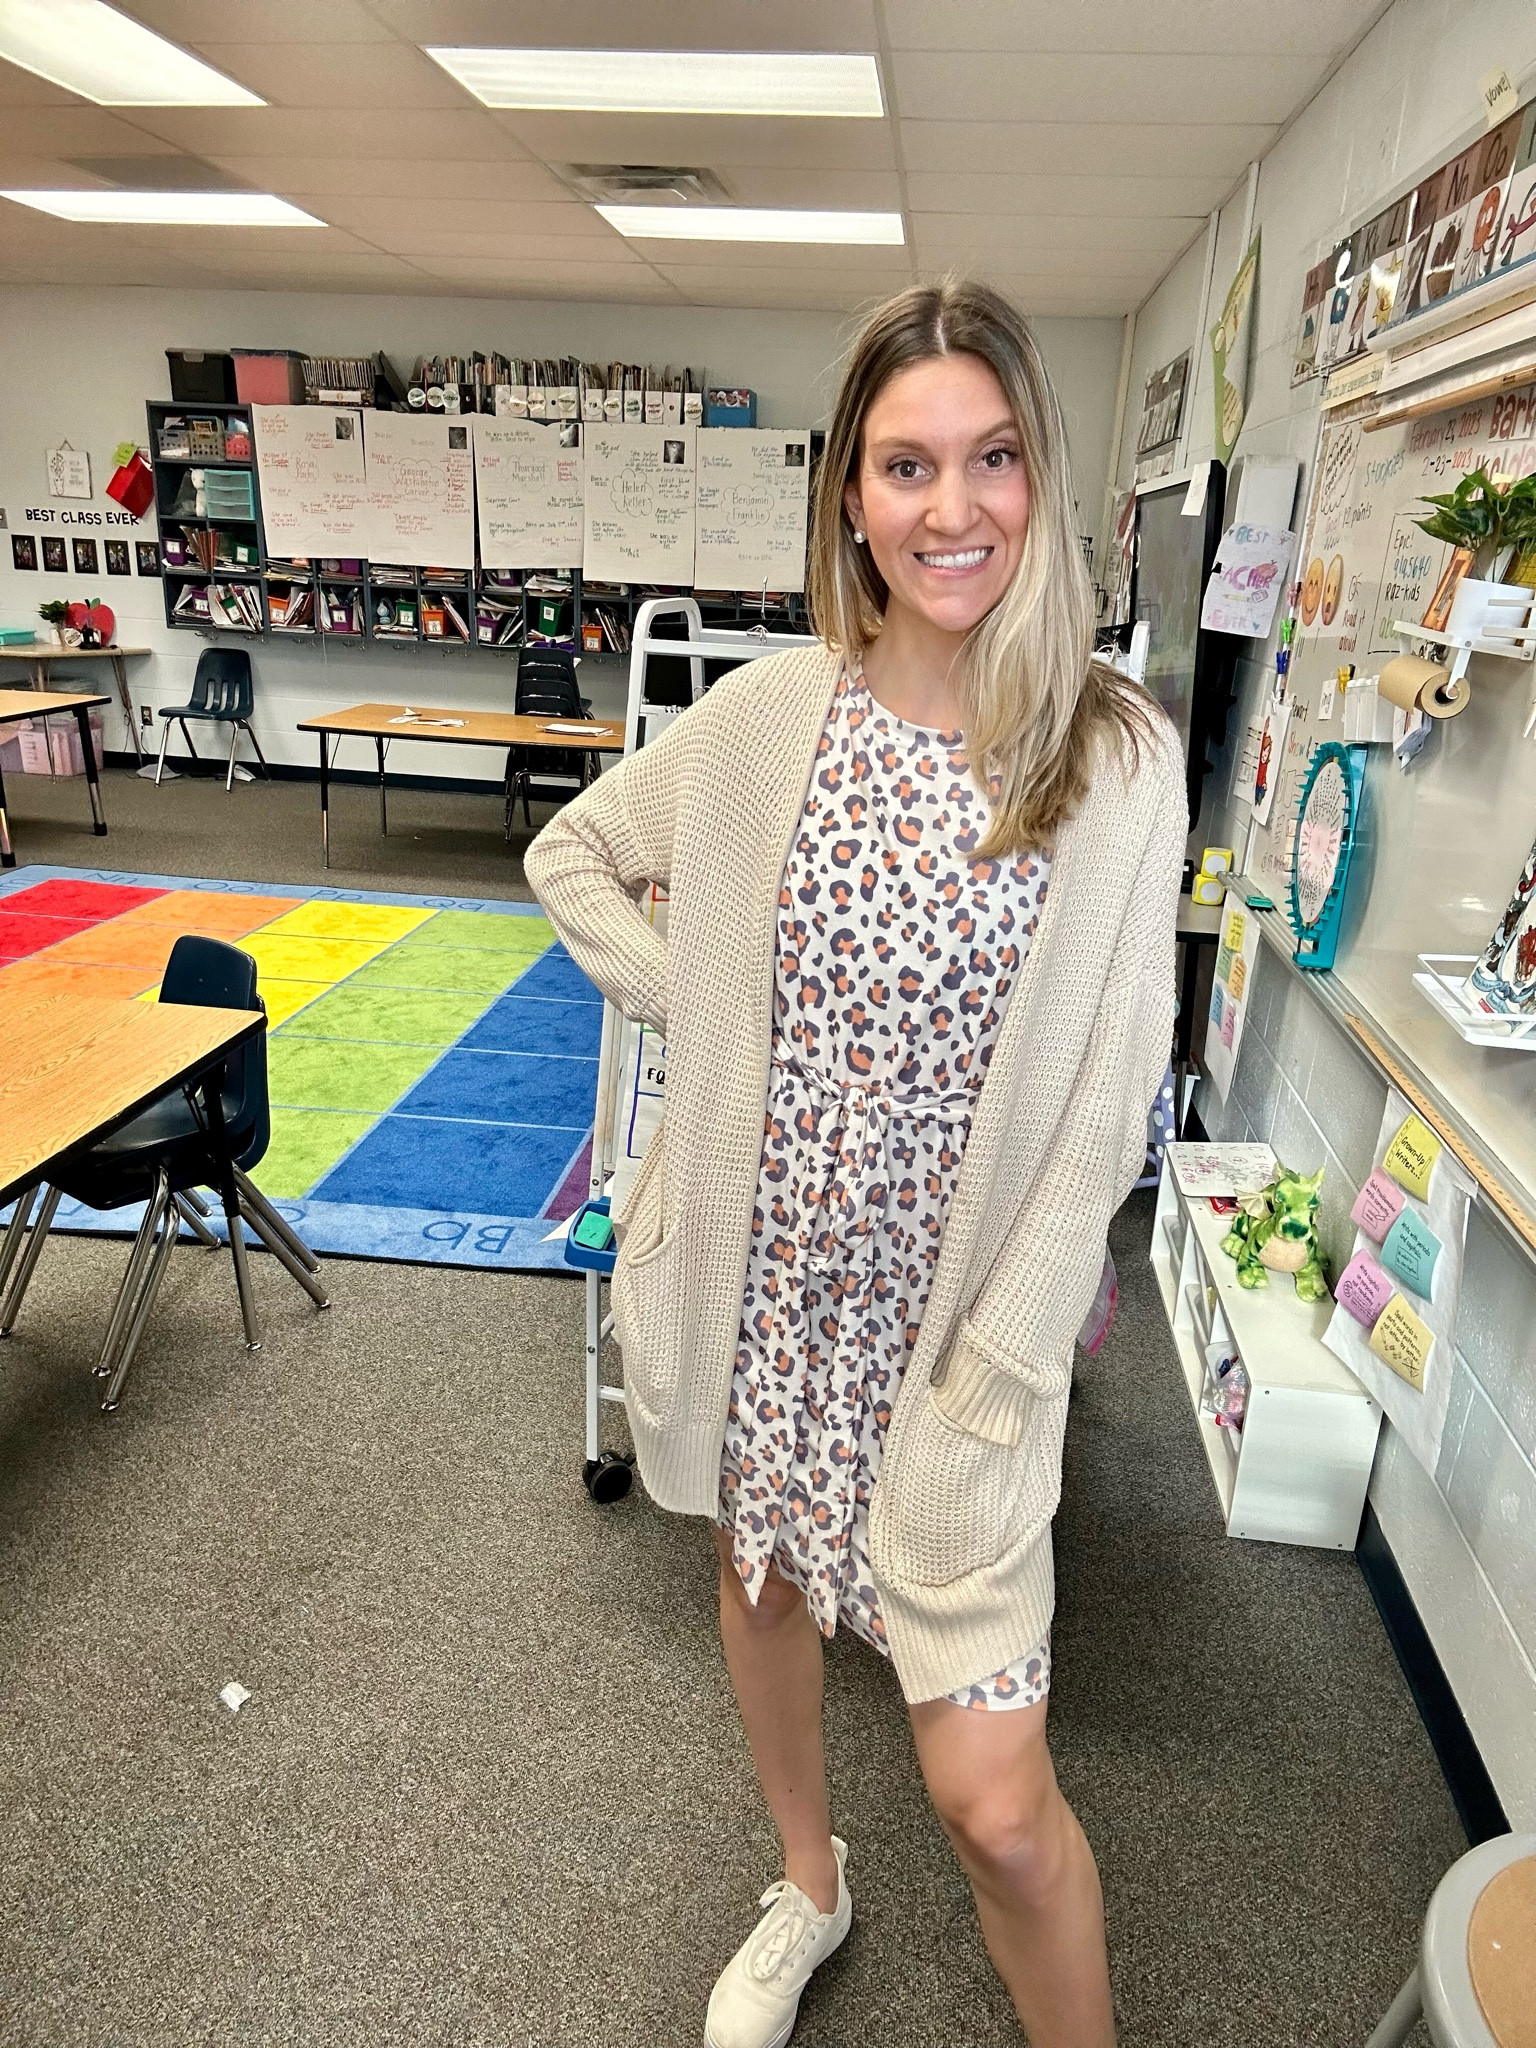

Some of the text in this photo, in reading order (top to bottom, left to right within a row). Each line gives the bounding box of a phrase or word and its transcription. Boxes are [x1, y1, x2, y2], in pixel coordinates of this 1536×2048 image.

[622, 480, 648, 494] Helen
[623, 495, 646, 508] Keller
[733, 492, 769, 507] Benjamin
[25, 508, 140, 526] BEST CLASS EVER
[733, 507, 766, 521] Franklin
[1400, 1136, 1426, 1167] Grown-Up
